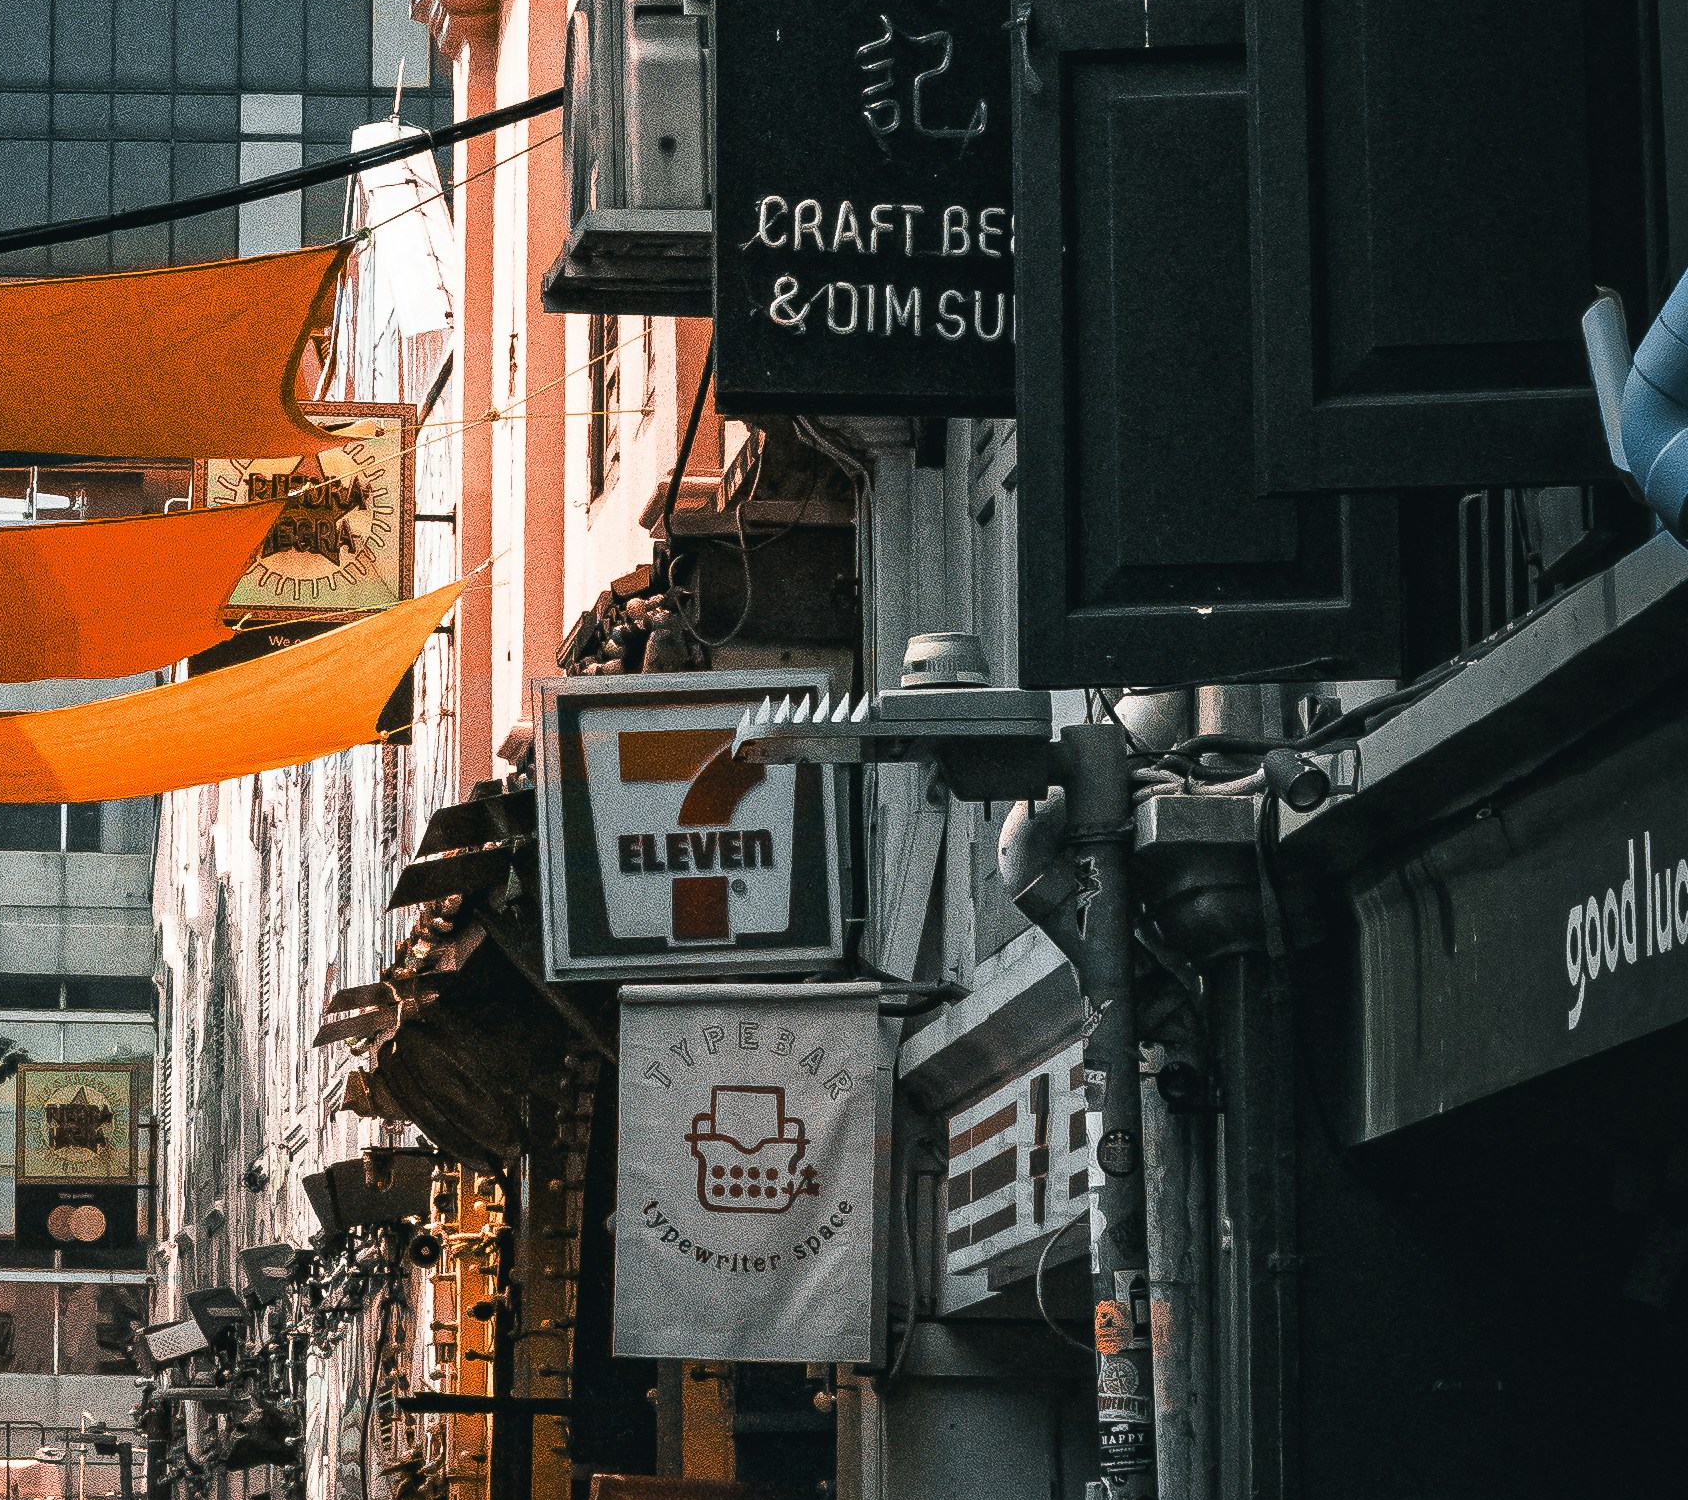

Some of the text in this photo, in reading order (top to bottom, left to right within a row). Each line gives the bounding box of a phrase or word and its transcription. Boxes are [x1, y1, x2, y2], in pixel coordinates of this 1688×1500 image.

[756, 195, 1016, 258] CRAFT BE
[768, 274, 1016, 343] & DIM SU
[268, 635, 291, 647] We
[1566, 838, 1637, 1030] good
[643, 1020, 854, 1101] TYPEBAR
[642, 1199, 855, 1274] typewriter space
